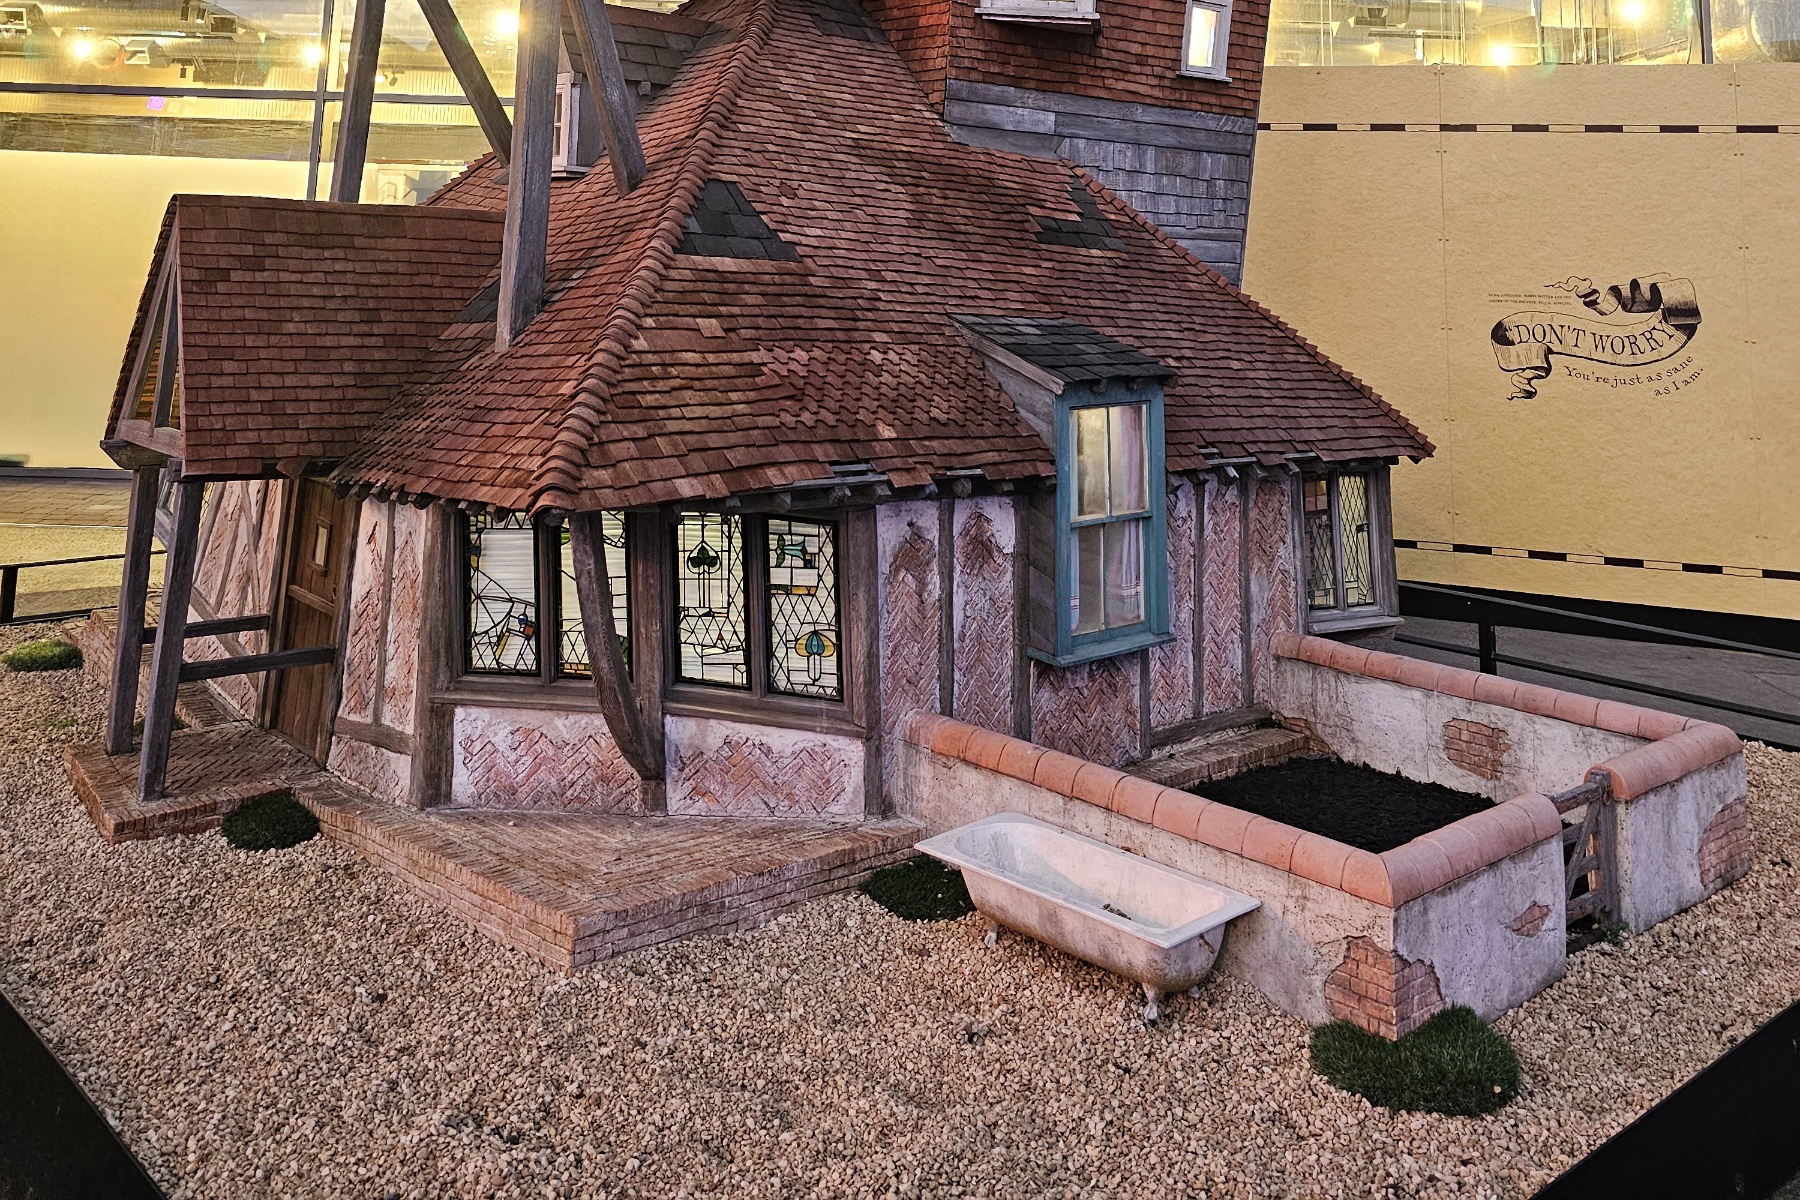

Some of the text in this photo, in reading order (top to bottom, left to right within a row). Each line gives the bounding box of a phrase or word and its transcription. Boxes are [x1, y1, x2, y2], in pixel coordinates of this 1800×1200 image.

[1590, 318, 1675, 356] WORRY
[1563, 356, 1694, 389] You're just as sane
[1653, 367, 1704, 396] as I am.
